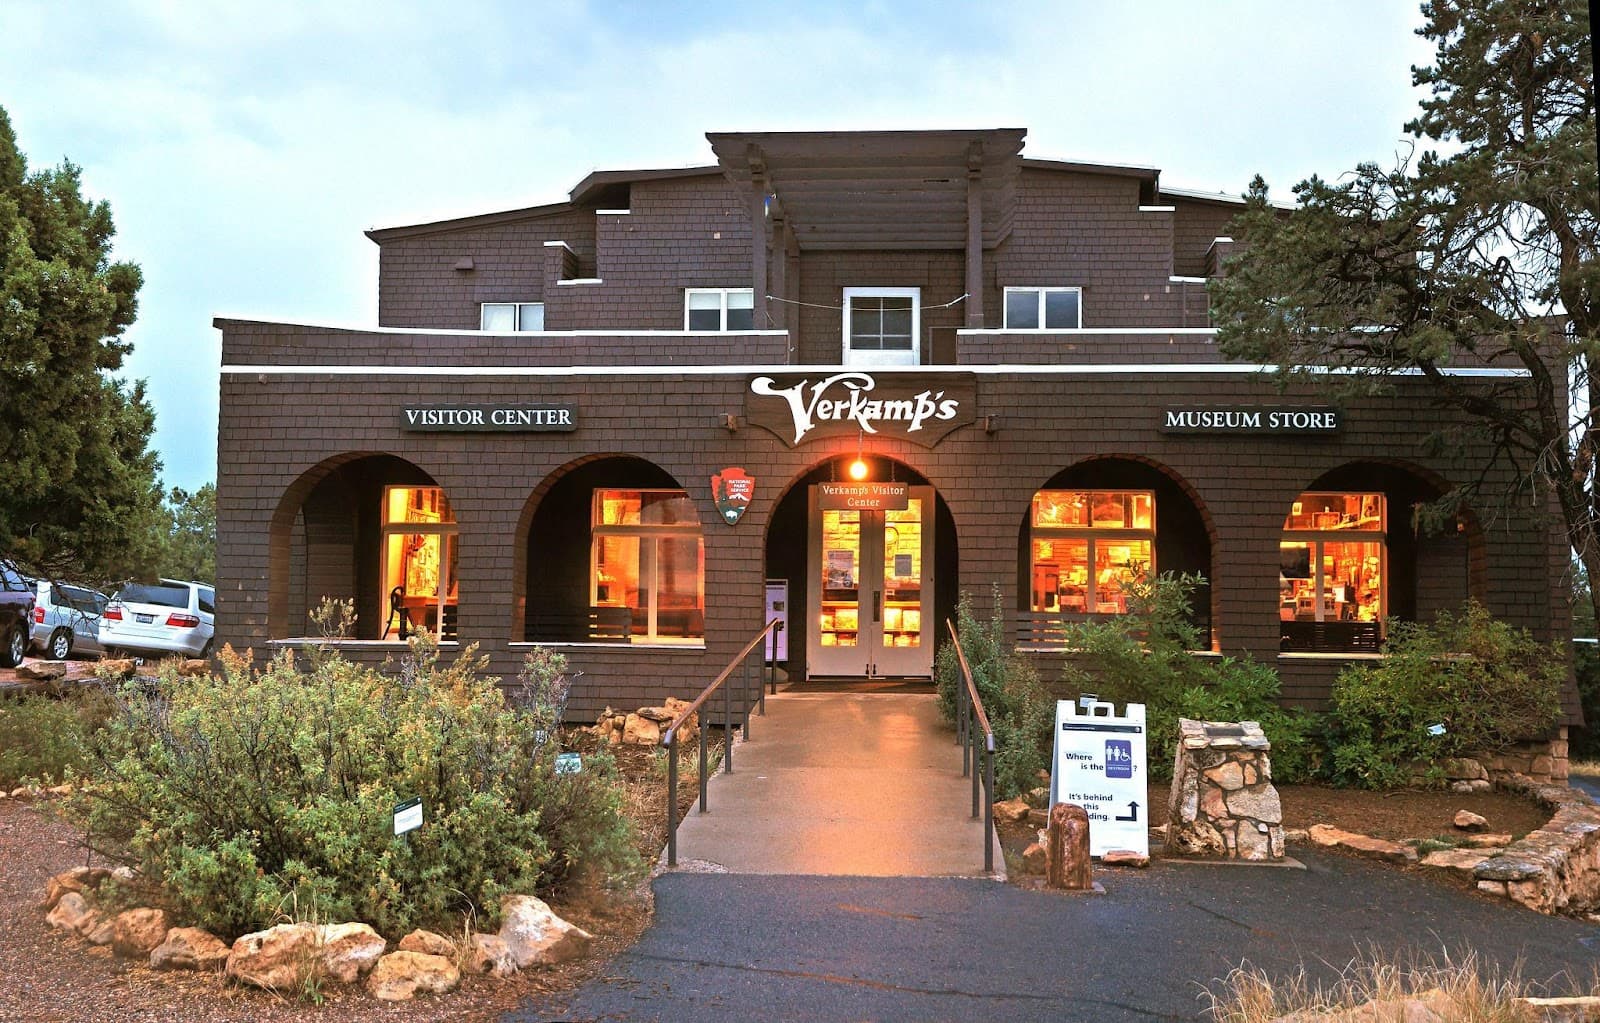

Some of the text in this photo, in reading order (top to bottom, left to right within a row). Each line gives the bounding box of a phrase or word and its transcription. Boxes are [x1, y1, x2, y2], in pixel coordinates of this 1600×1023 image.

[750, 372, 960, 445] Verkamp's
[405, 409, 572, 425] VISITOR CENTER
[1165, 411, 1337, 429] MUSEUM STORE
[823, 485, 905, 496] Verkamp's Visitor
[847, 497, 880, 507] Center
[1066, 753, 1093, 761] Where
[1090, 763, 1104, 771] the
[1083, 793, 1113, 801] behind
